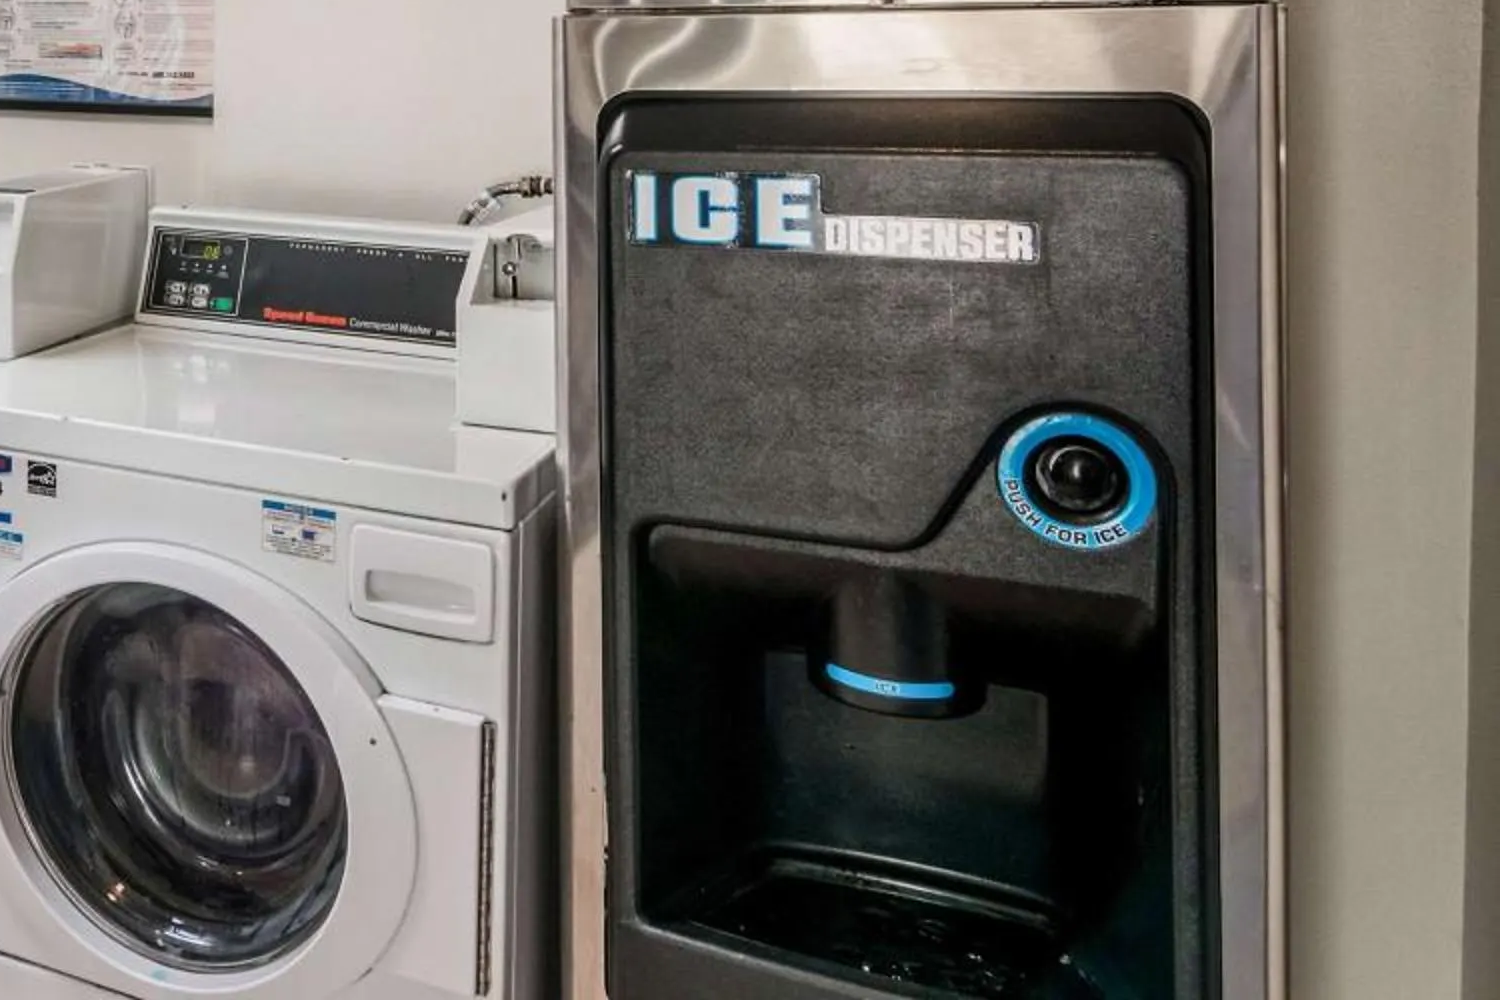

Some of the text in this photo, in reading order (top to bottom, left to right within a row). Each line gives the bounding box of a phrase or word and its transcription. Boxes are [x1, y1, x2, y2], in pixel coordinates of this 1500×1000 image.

[632, 174, 1035, 262] ICE DISPENSER
[349, 317, 399, 332] Commercial
[399, 323, 432, 336] Washer
[1003, 478, 1128, 545] PUSH FOR ICE
